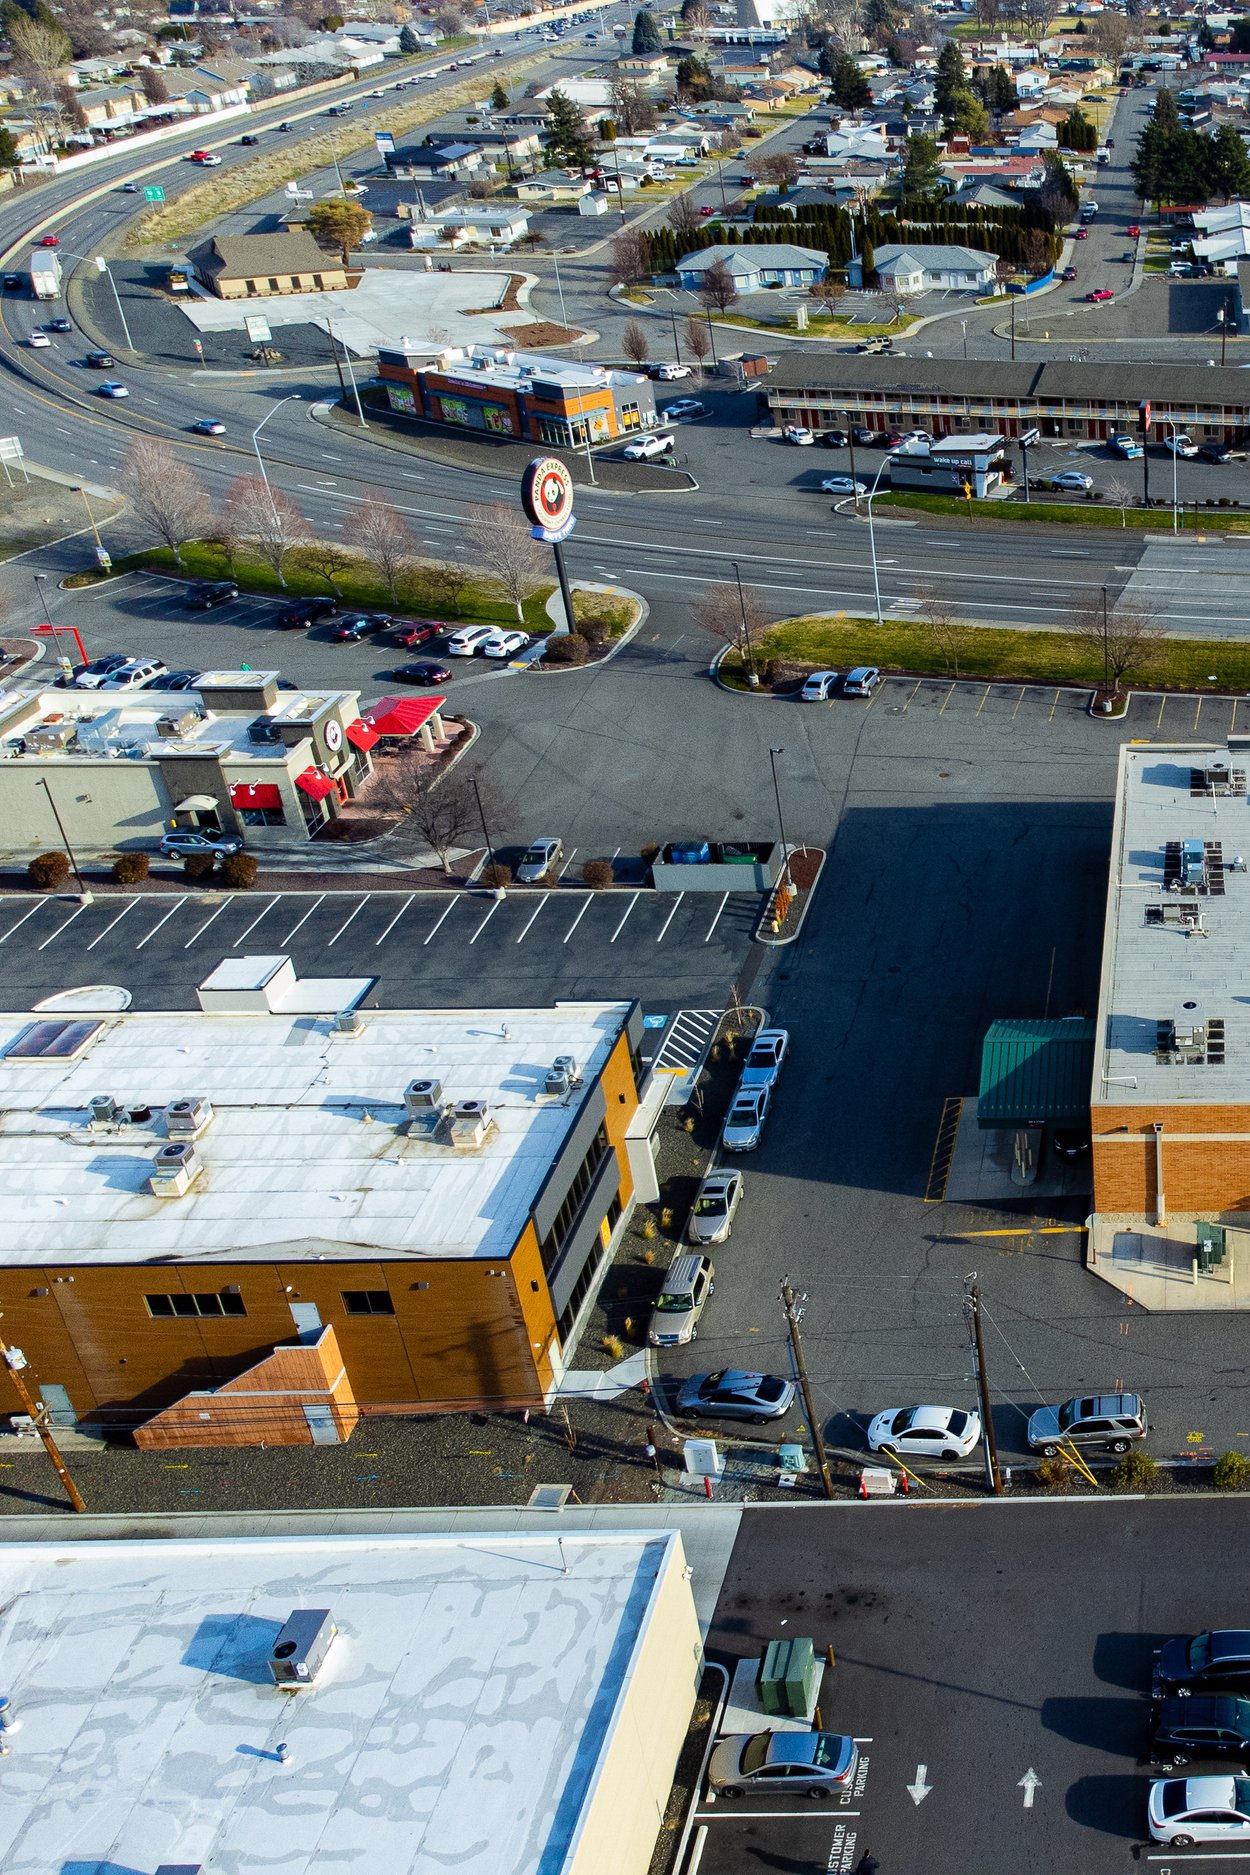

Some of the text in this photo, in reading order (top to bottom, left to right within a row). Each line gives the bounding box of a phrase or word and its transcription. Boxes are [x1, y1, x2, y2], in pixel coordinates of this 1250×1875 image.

[534, 462, 570, 502] PANDA EXPRESS
[853, 1756, 870, 1797] PARKING
[826, 1824, 846, 1875] USTOMER
